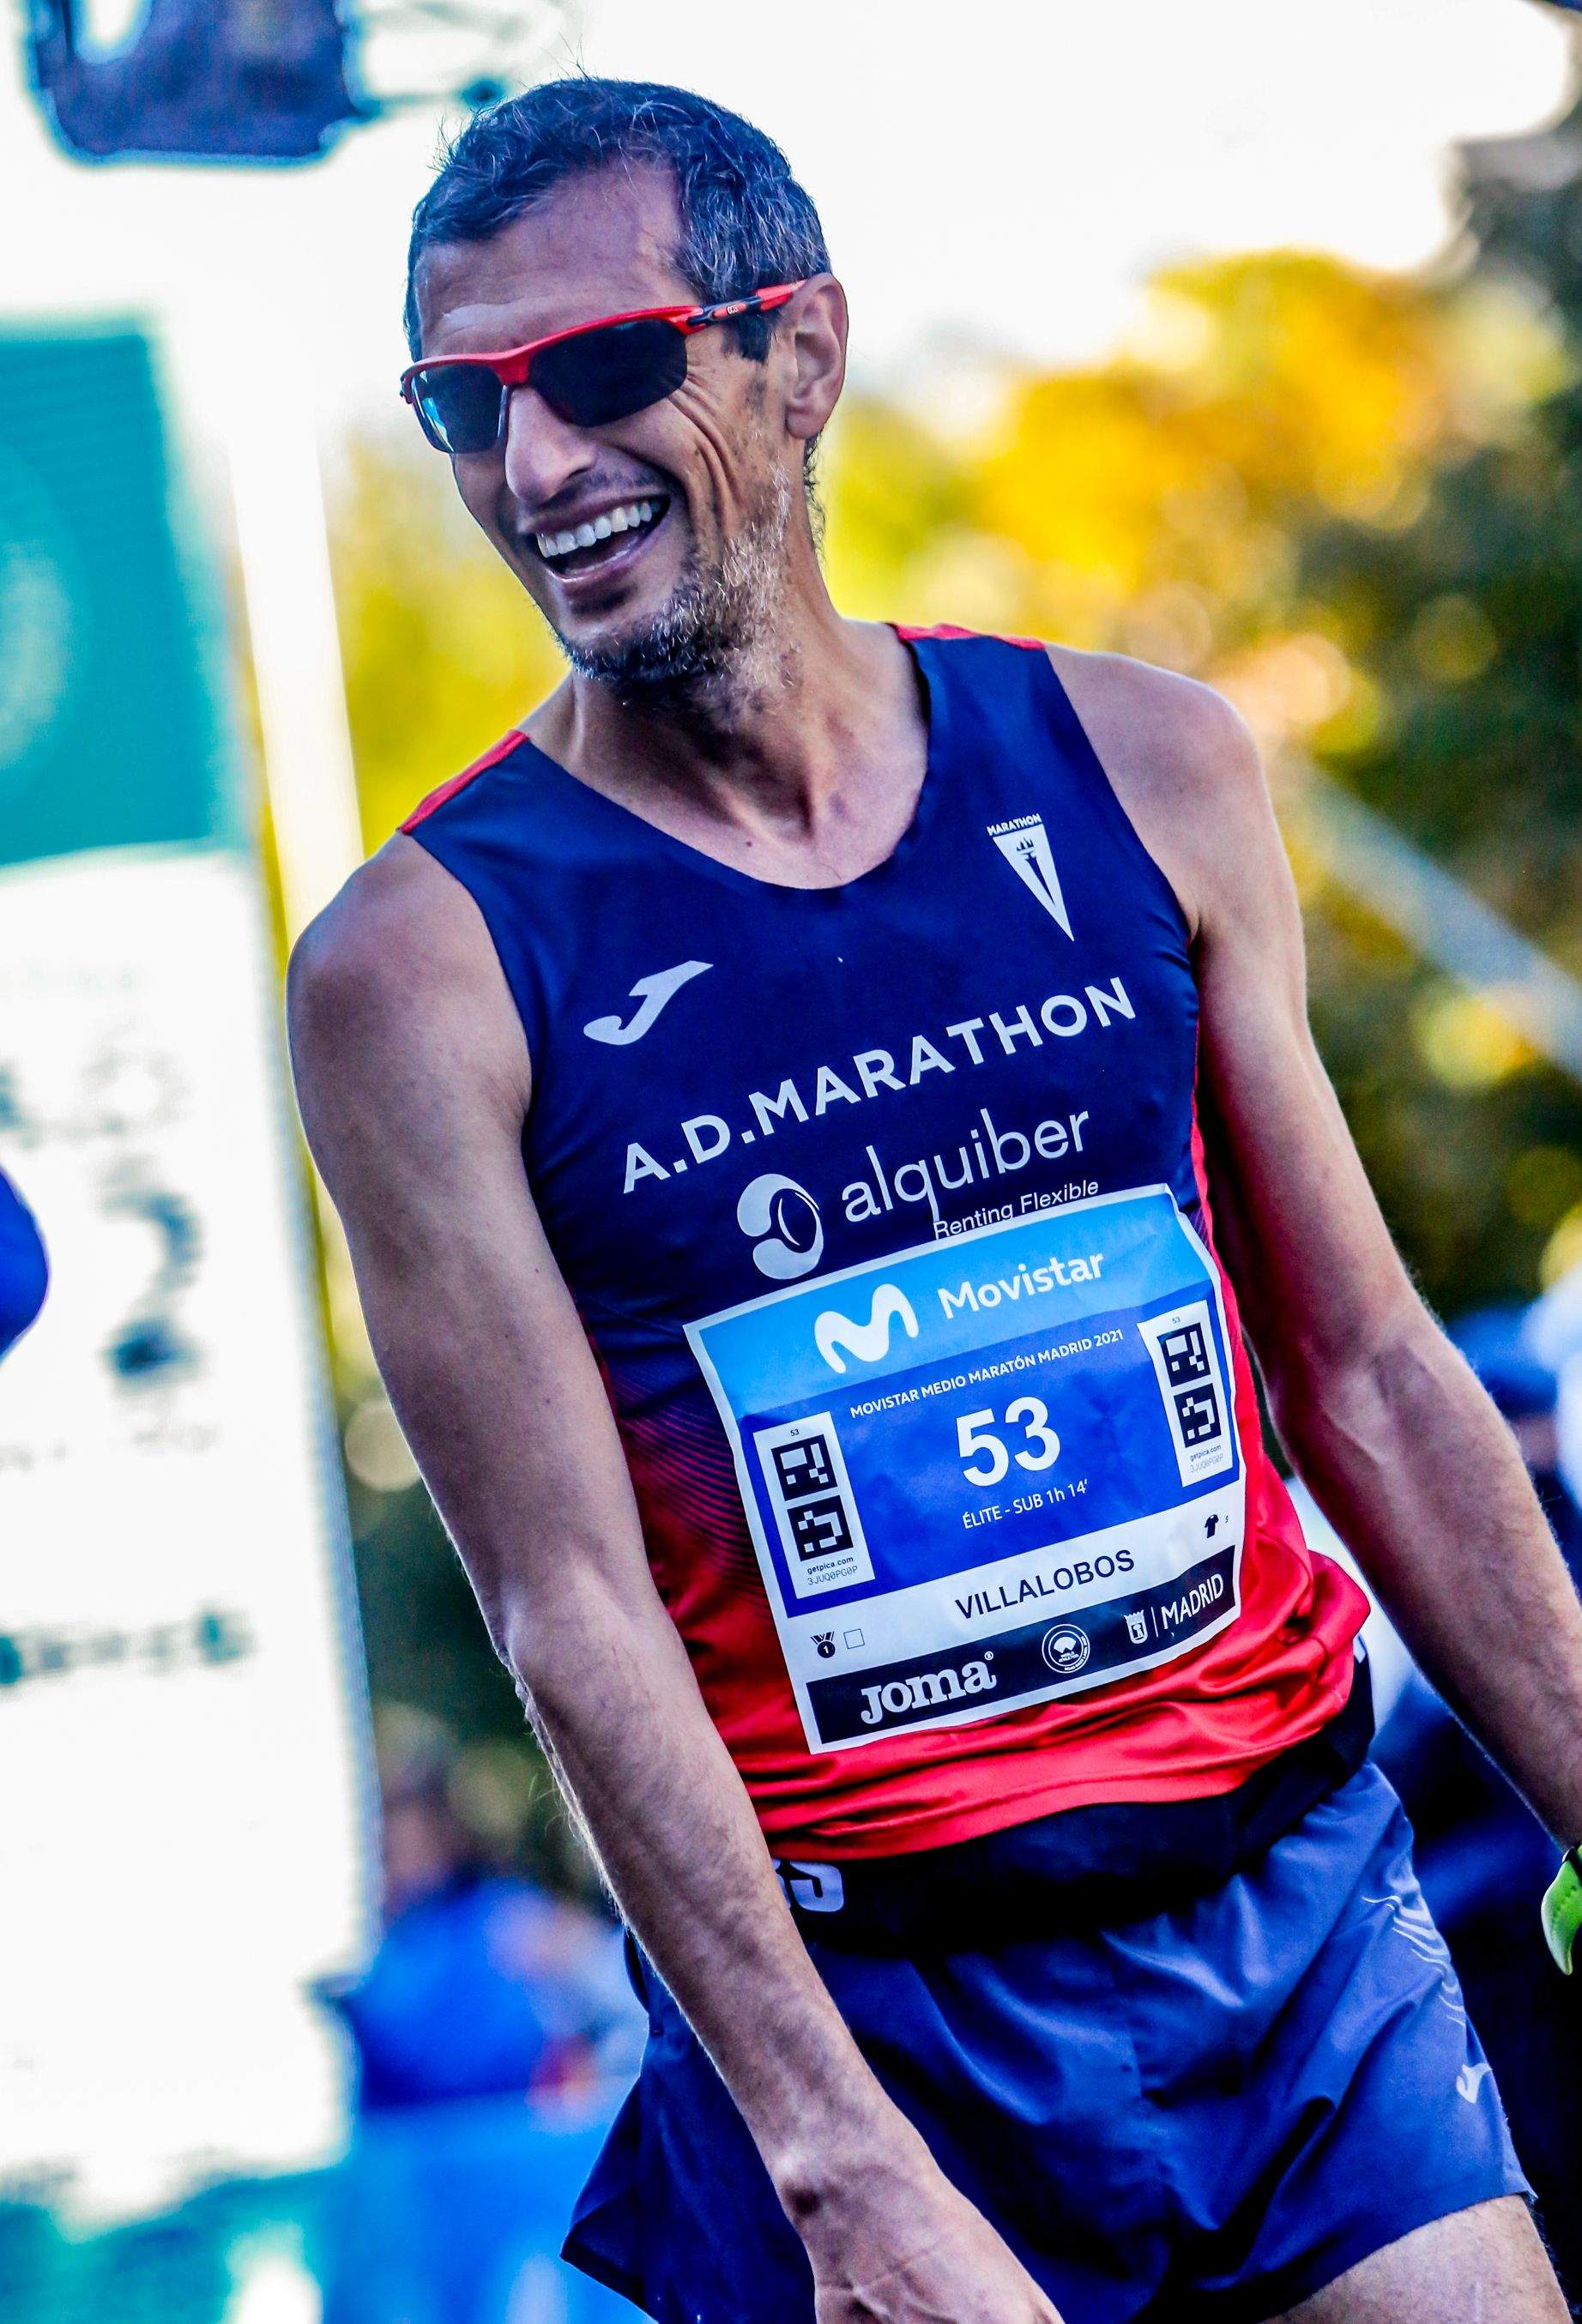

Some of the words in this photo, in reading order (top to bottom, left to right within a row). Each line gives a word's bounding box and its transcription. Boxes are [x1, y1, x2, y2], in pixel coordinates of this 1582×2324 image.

[987, 812, 1042, 836] MARATHON
[842, 1108, 1090, 1222] alquiber
[933, 1204, 1014, 1240] Renting
[1020, 1180, 1099, 1214] Flexible
[937, 1253, 1105, 1319] Movistar
[849, 1383, 920, 1419] MOVISTAR
[921, 1374, 966, 1399] MEDIO
[969, 1354, 1036, 1385] MARATÓN
[1038, 1337, 1093, 1364] MADRID
[1096, 1328, 1125, 1348] 2021
[789, 1428, 800, 1437] 53
[956, 1396, 1061, 1487] 53
[962, 1505, 1003, 1530] ÉLITE
[1012, 1493, 1044, 1514] SUB
[1046, 1487, 1066, 1504] 1h
[806, 1556, 854, 1576] getpica.com
[955, 1549, 1135, 1620] VILLALOBOS
[1161, 1572, 1224, 1630] MADRID
